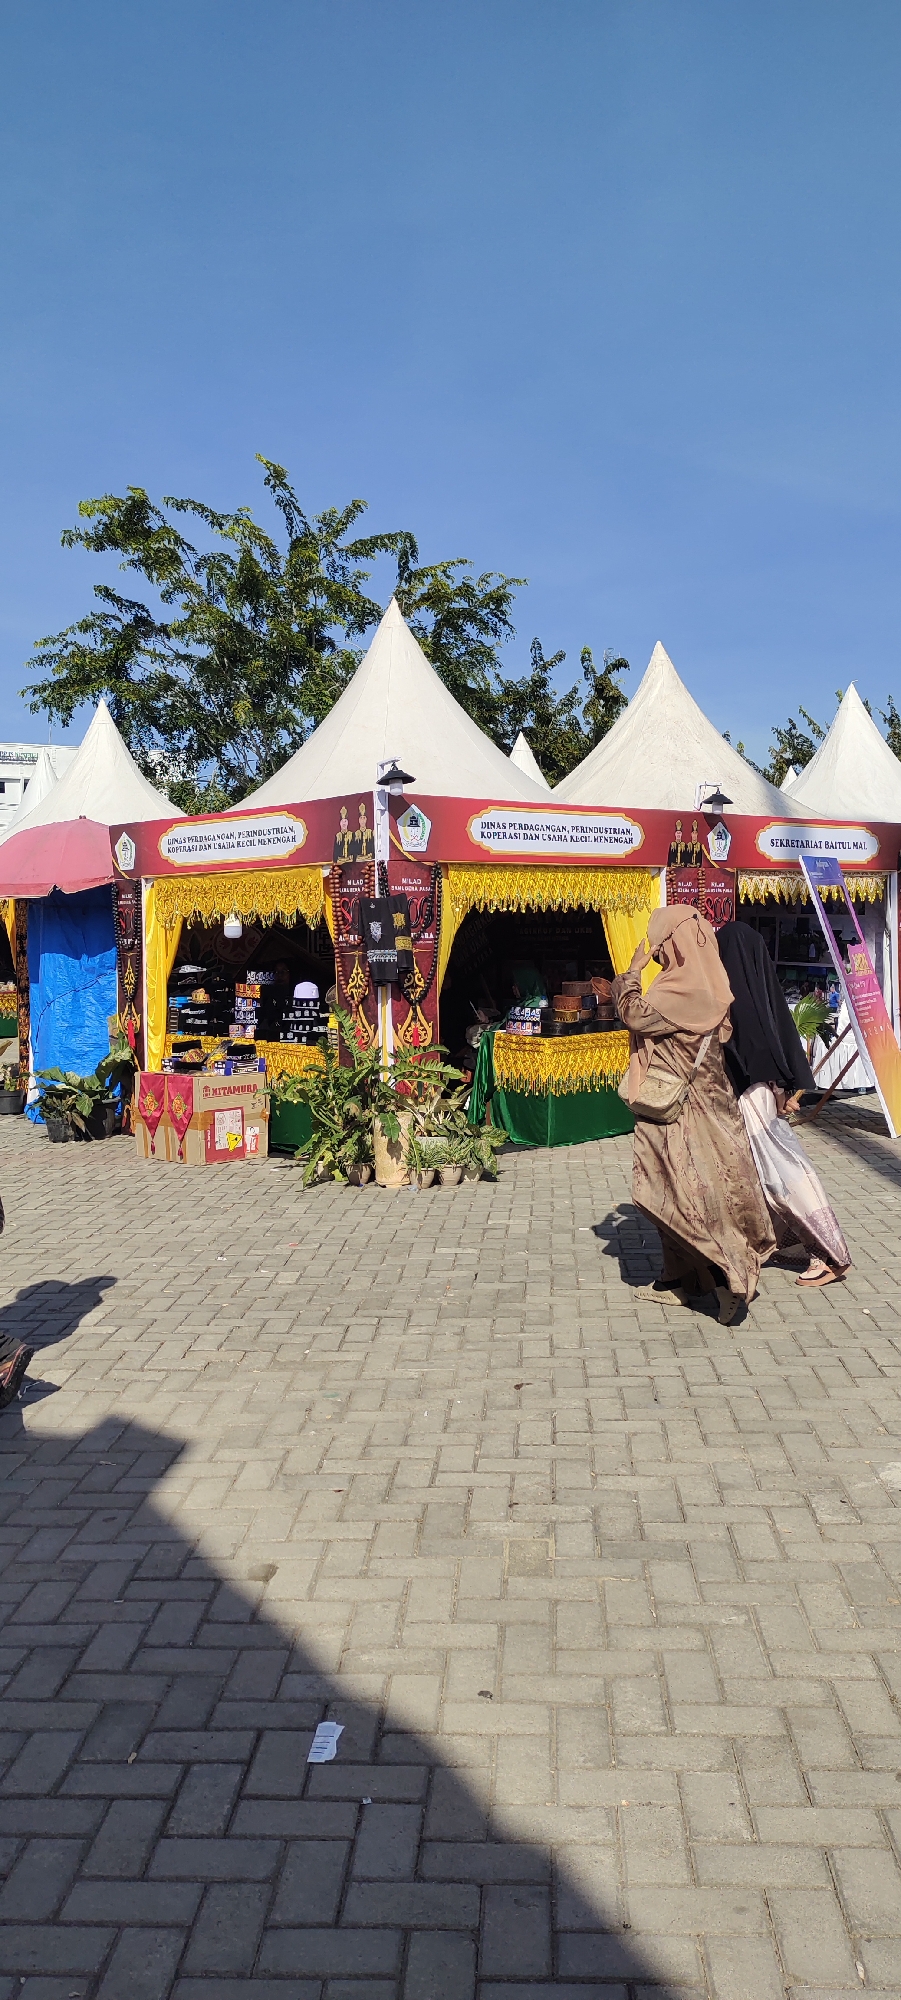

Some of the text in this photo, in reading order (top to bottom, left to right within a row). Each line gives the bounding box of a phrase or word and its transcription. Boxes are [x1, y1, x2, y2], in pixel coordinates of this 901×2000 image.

[481, 821, 633, 836] DINAS PERDAGANGAN, PERINDUSTRIAN,
[167, 835, 297, 854] KOPERASI DAN USAHA KECIL MENENGAH
[168, 837, 186, 845] DINAS
[481, 831, 634, 845] KOPERASI DAN USAHA KECIL MENENGAH
[770, 838, 823, 849] SEKRETARIAT
[824, 840, 851, 850] BAITUL
